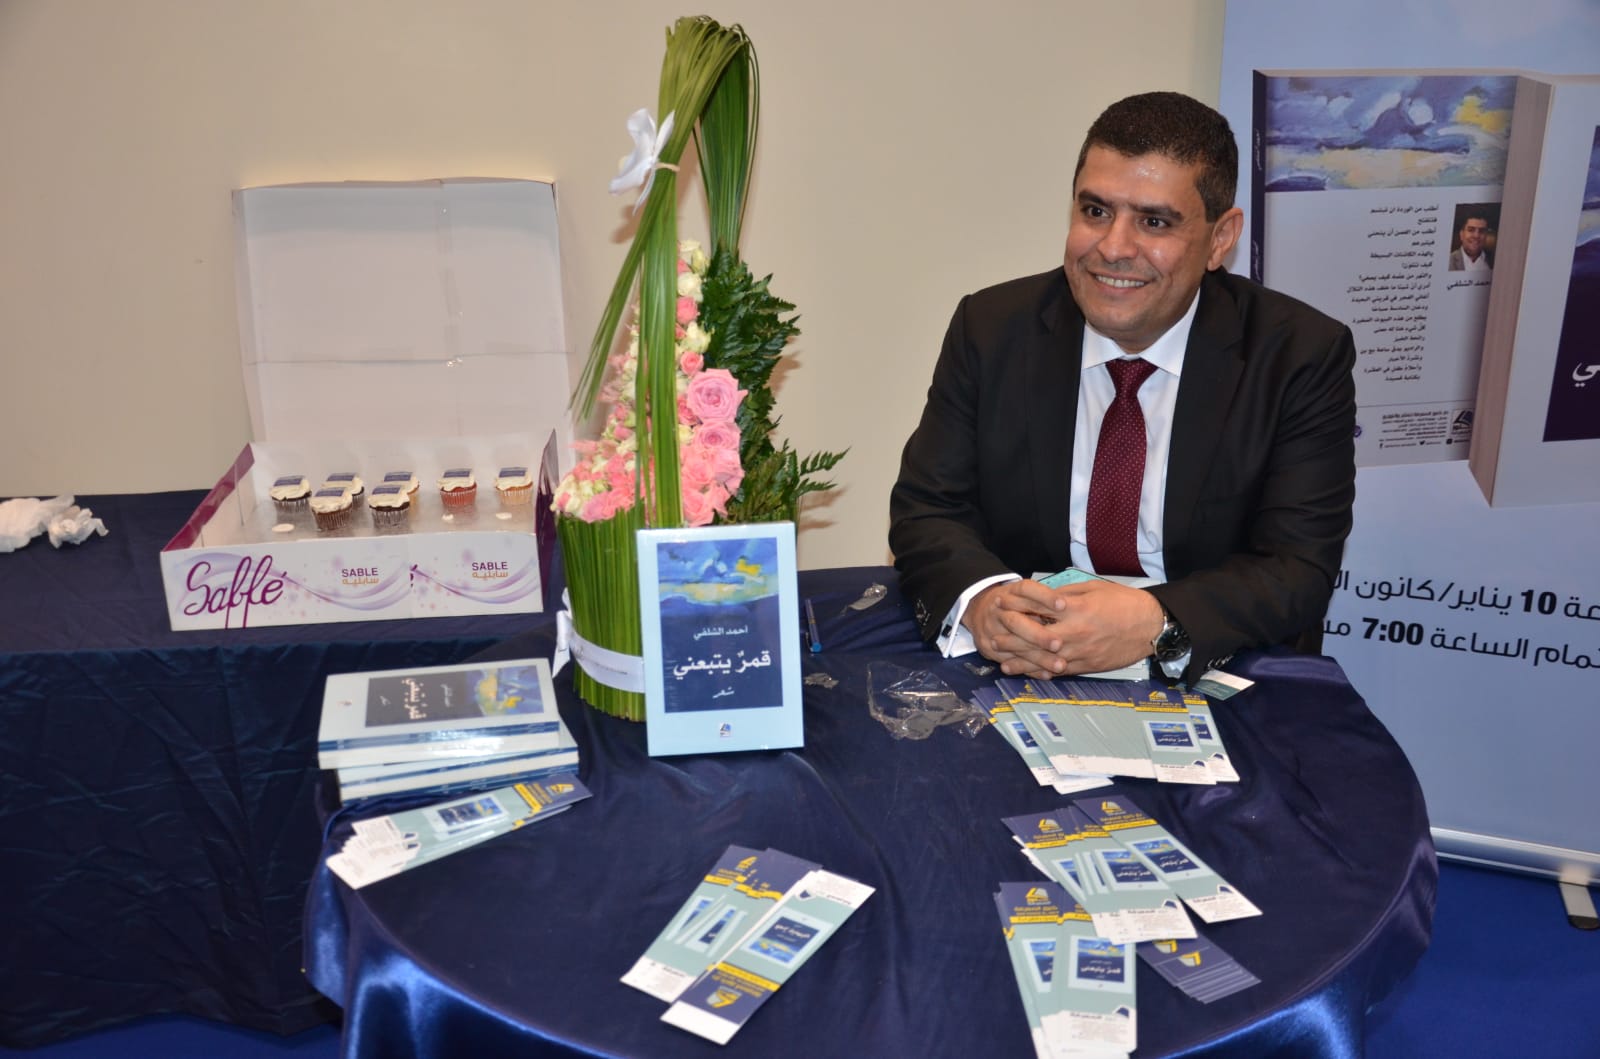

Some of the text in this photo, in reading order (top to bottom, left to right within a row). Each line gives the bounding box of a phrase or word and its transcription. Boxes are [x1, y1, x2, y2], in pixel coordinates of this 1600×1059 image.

[342, 567, 378, 578] SABLE
[471, 561, 508, 571] SABLE
[1520, 589, 1557, 614] 10
[693, 624, 748, 640] أحمد الشلفي
[1362, 617, 1424, 646] 7:00
[1430, 627, 1529, 660] الساعة
[673, 654, 732, 680] يتبعني
[712, 686, 734, 699] شعر
